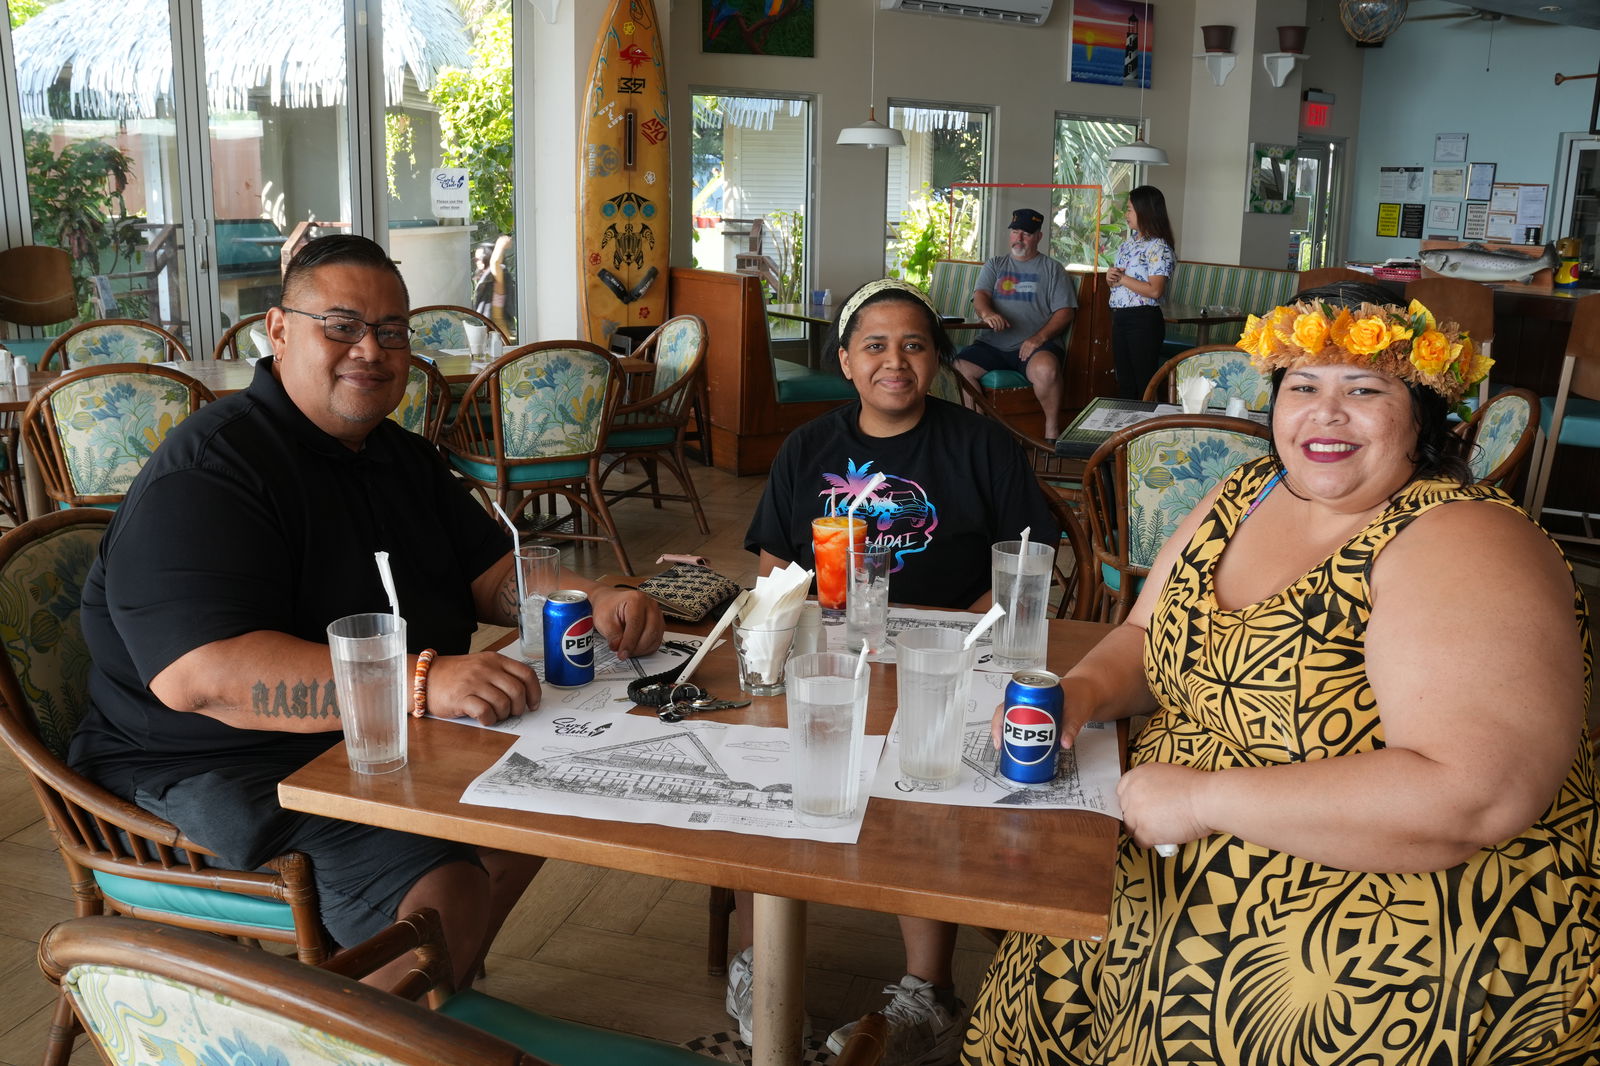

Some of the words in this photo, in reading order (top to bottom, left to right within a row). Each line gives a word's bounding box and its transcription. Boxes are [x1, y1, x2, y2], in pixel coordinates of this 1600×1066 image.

[1308, 103, 1329, 128] EXIT
[565, 635, 594, 650] PEP
[552, 717, 591, 730] Surf
[554, 727, 588, 735] Club
[1004, 721, 1054, 743] PEPSI
